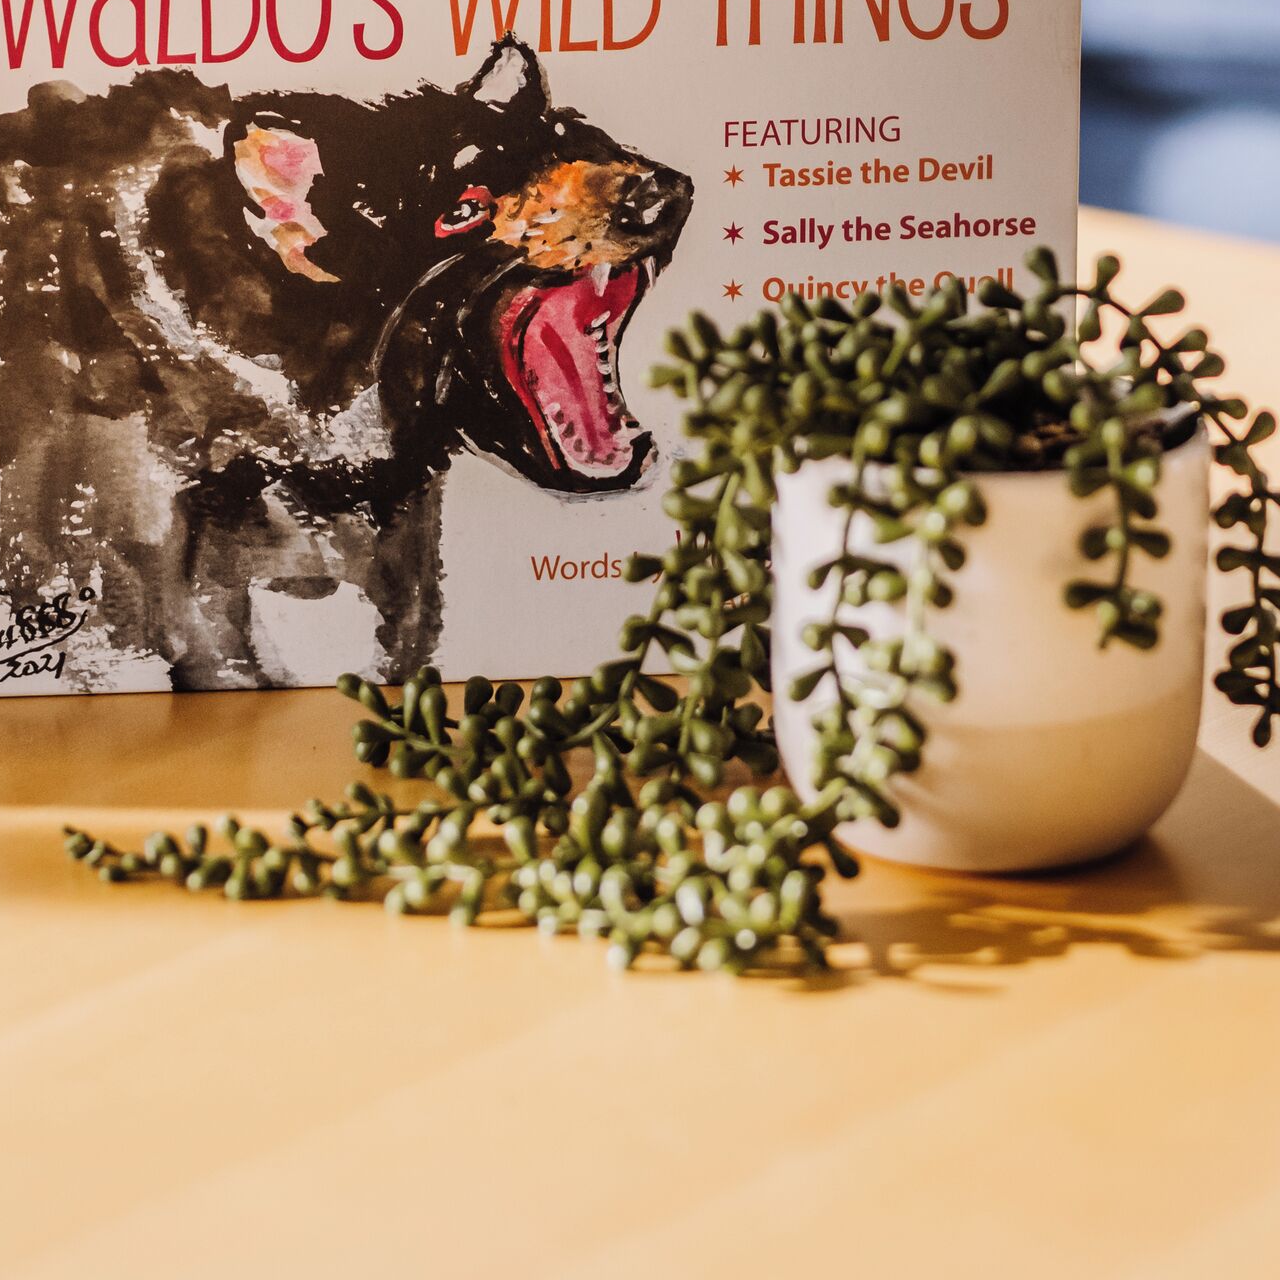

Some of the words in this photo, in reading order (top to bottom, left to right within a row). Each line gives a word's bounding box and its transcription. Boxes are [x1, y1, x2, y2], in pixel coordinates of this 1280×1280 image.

[723, 115, 902, 148] FEATURING
[763, 160, 852, 188] Tassie
[860, 158, 910, 184] the
[918, 153, 994, 182] Devil
[763, 217, 835, 251] Sally
[842, 215, 892, 243] the
[899, 212, 1038, 241] Seahorse
[762, 275, 869, 303] Quincy
[531, 552, 622, 581] Words
